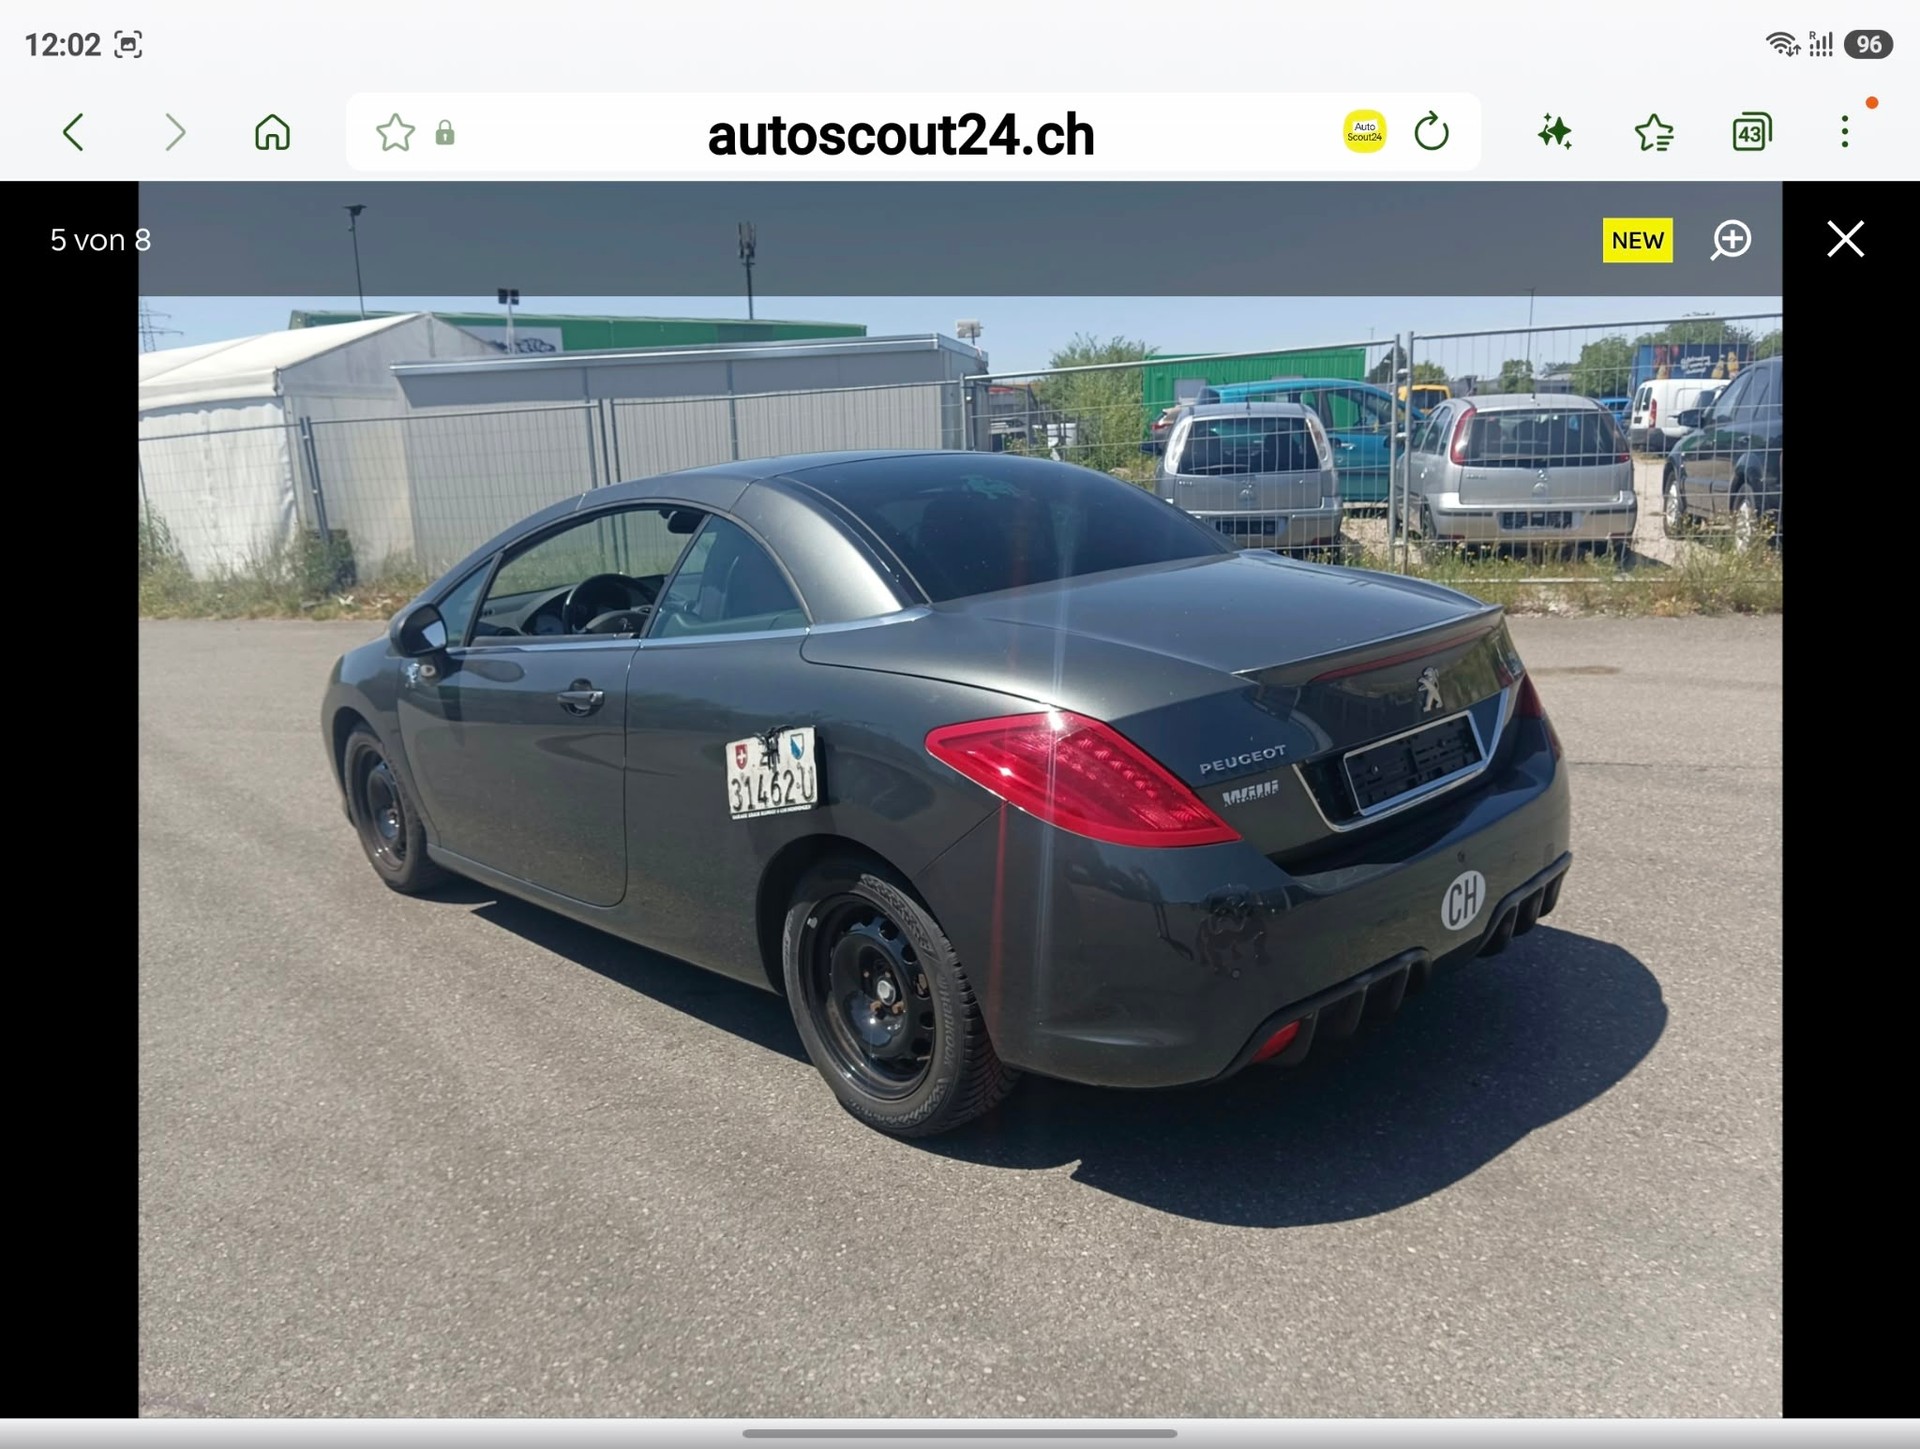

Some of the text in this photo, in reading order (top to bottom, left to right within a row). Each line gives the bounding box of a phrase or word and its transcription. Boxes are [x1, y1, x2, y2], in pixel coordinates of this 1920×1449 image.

[25, 32, 102, 57] 12:02
[1856, 35, 1883, 54] 96
[708, 110, 1094, 156] autoscout24.ch
[1347, 132, 1383, 142] Scout24
[1354, 122, 1376, 131] Auto
[1738, 126, 1761, 143] 43
[1200, 744, 1286, 775] PEUGEOT
[1449, 879, 1477, 927] CH
